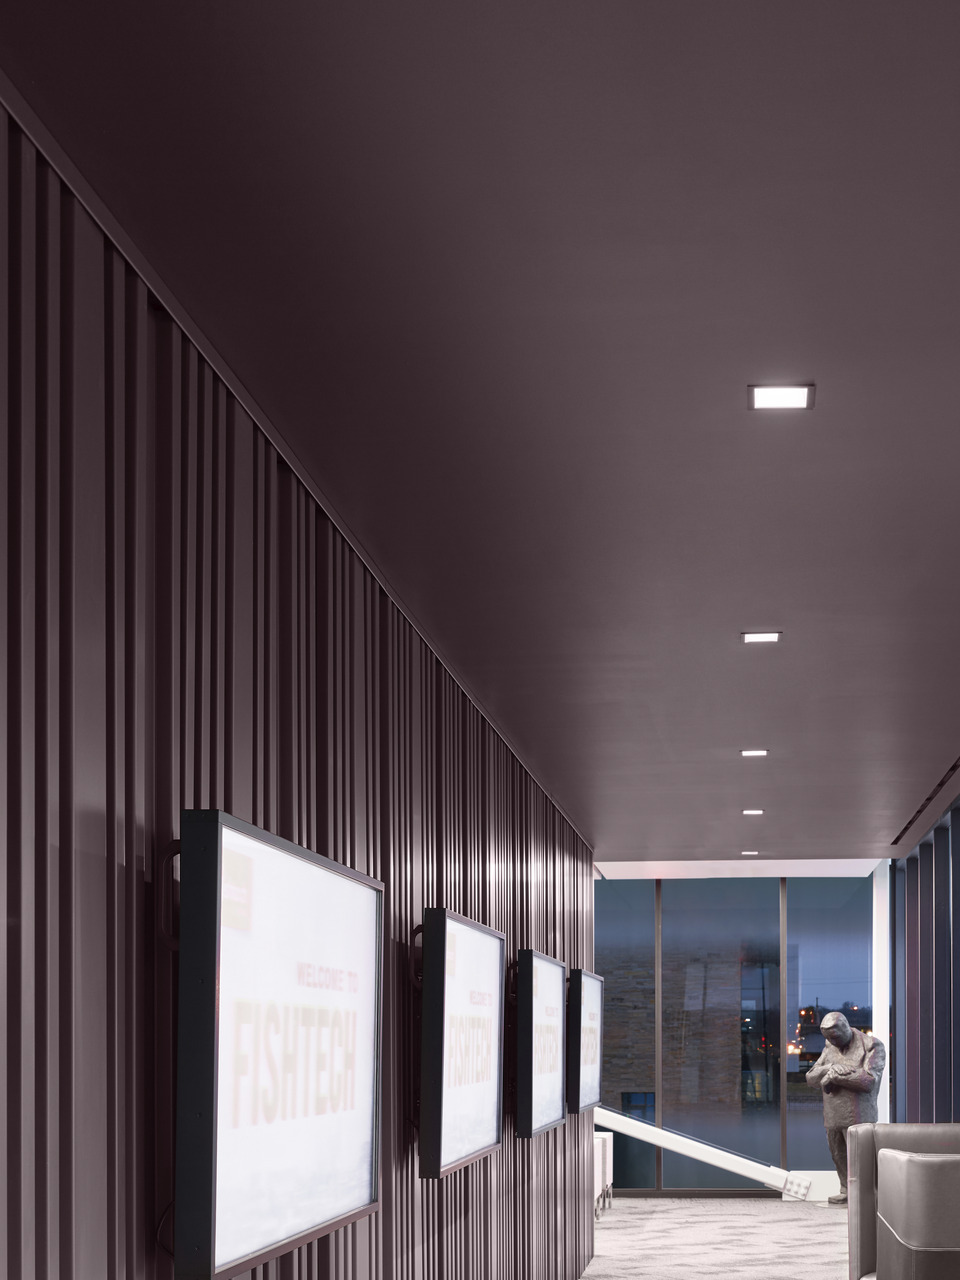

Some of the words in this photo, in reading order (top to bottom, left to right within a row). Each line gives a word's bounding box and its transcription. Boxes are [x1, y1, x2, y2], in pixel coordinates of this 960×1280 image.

[298, 962, 345, 992] WELCOME
[348, 971, 358, 994] TO
[232, 1000, 357, 1129] FISHTECH
[448, 1015, 492, 1087] FISHTECH
